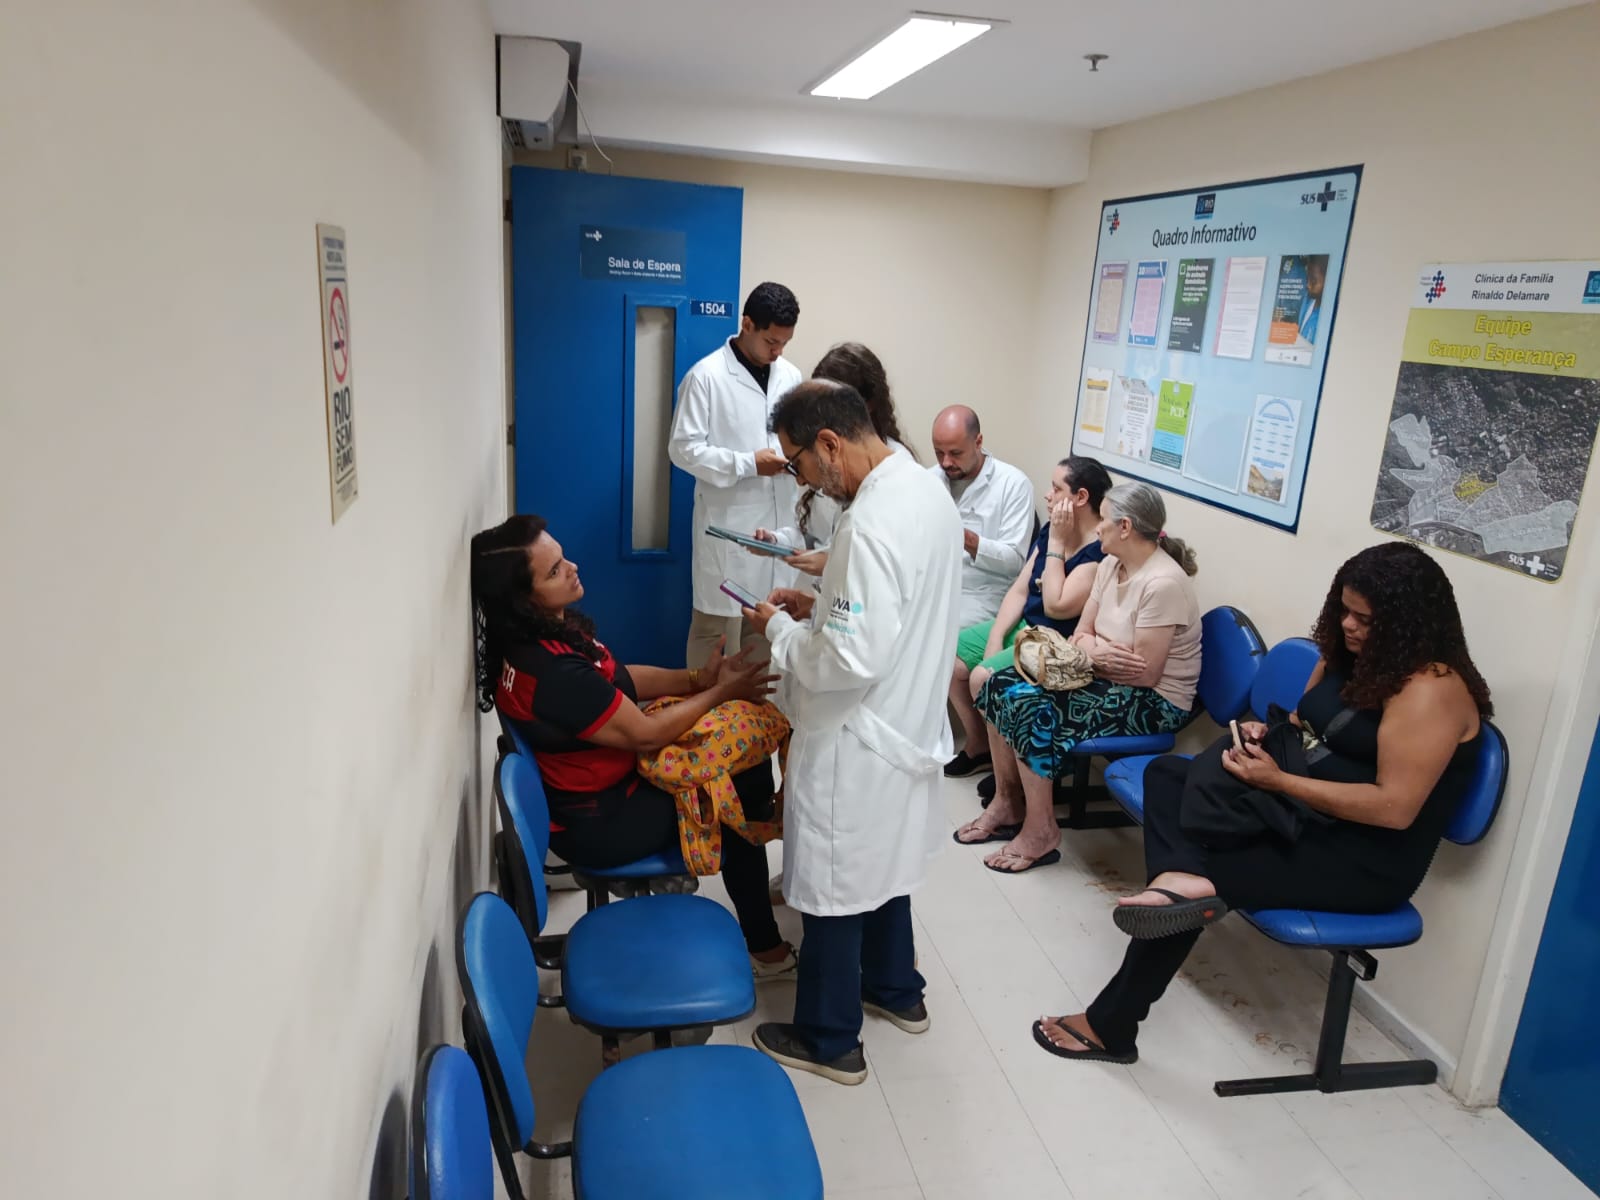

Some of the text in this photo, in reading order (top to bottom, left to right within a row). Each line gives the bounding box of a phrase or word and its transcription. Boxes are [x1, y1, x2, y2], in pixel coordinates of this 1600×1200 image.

[1300, 193, 1316, 205] SUS
[1152, 221, 1257, 248] Quadro Informativo
[608, 256, 681, 273] Sala de Espera
[1506, 273, 1518, 284] da
[1471, 290, 1550, 302] Rinaldo Delamare
[699, 303, 726, 315] 1504
[1474, 315, 1533, 338] Equipe
[1428, 339, 1576, 370] Campo Esperança
[333, 386, 351, 427] RIO
[335, 420, 353, 454] SEM
[337, 447, 353, 475] FUMO
[1508, 553, 1525, 566] SUS
